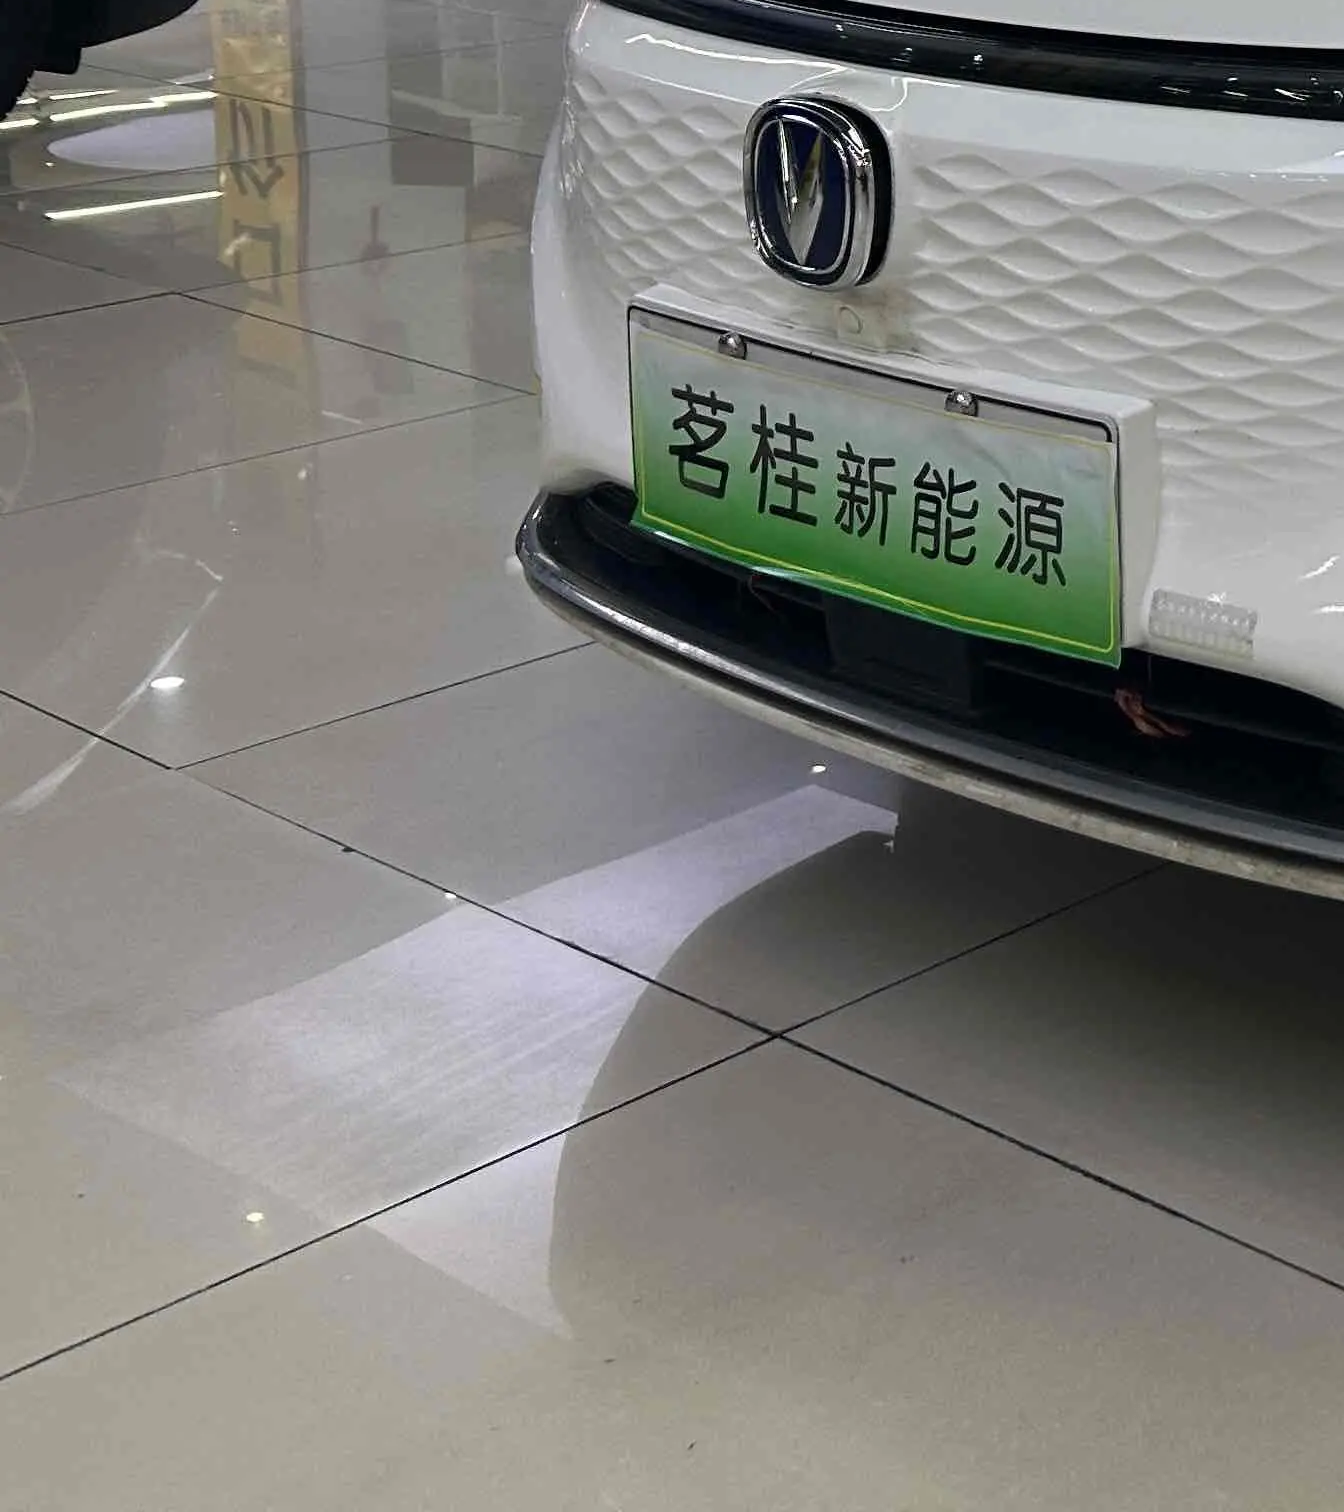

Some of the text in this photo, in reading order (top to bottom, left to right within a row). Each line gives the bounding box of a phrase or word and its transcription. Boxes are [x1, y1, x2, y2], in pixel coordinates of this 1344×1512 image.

[667, 382, 1068, 587] 茗桂新能源
